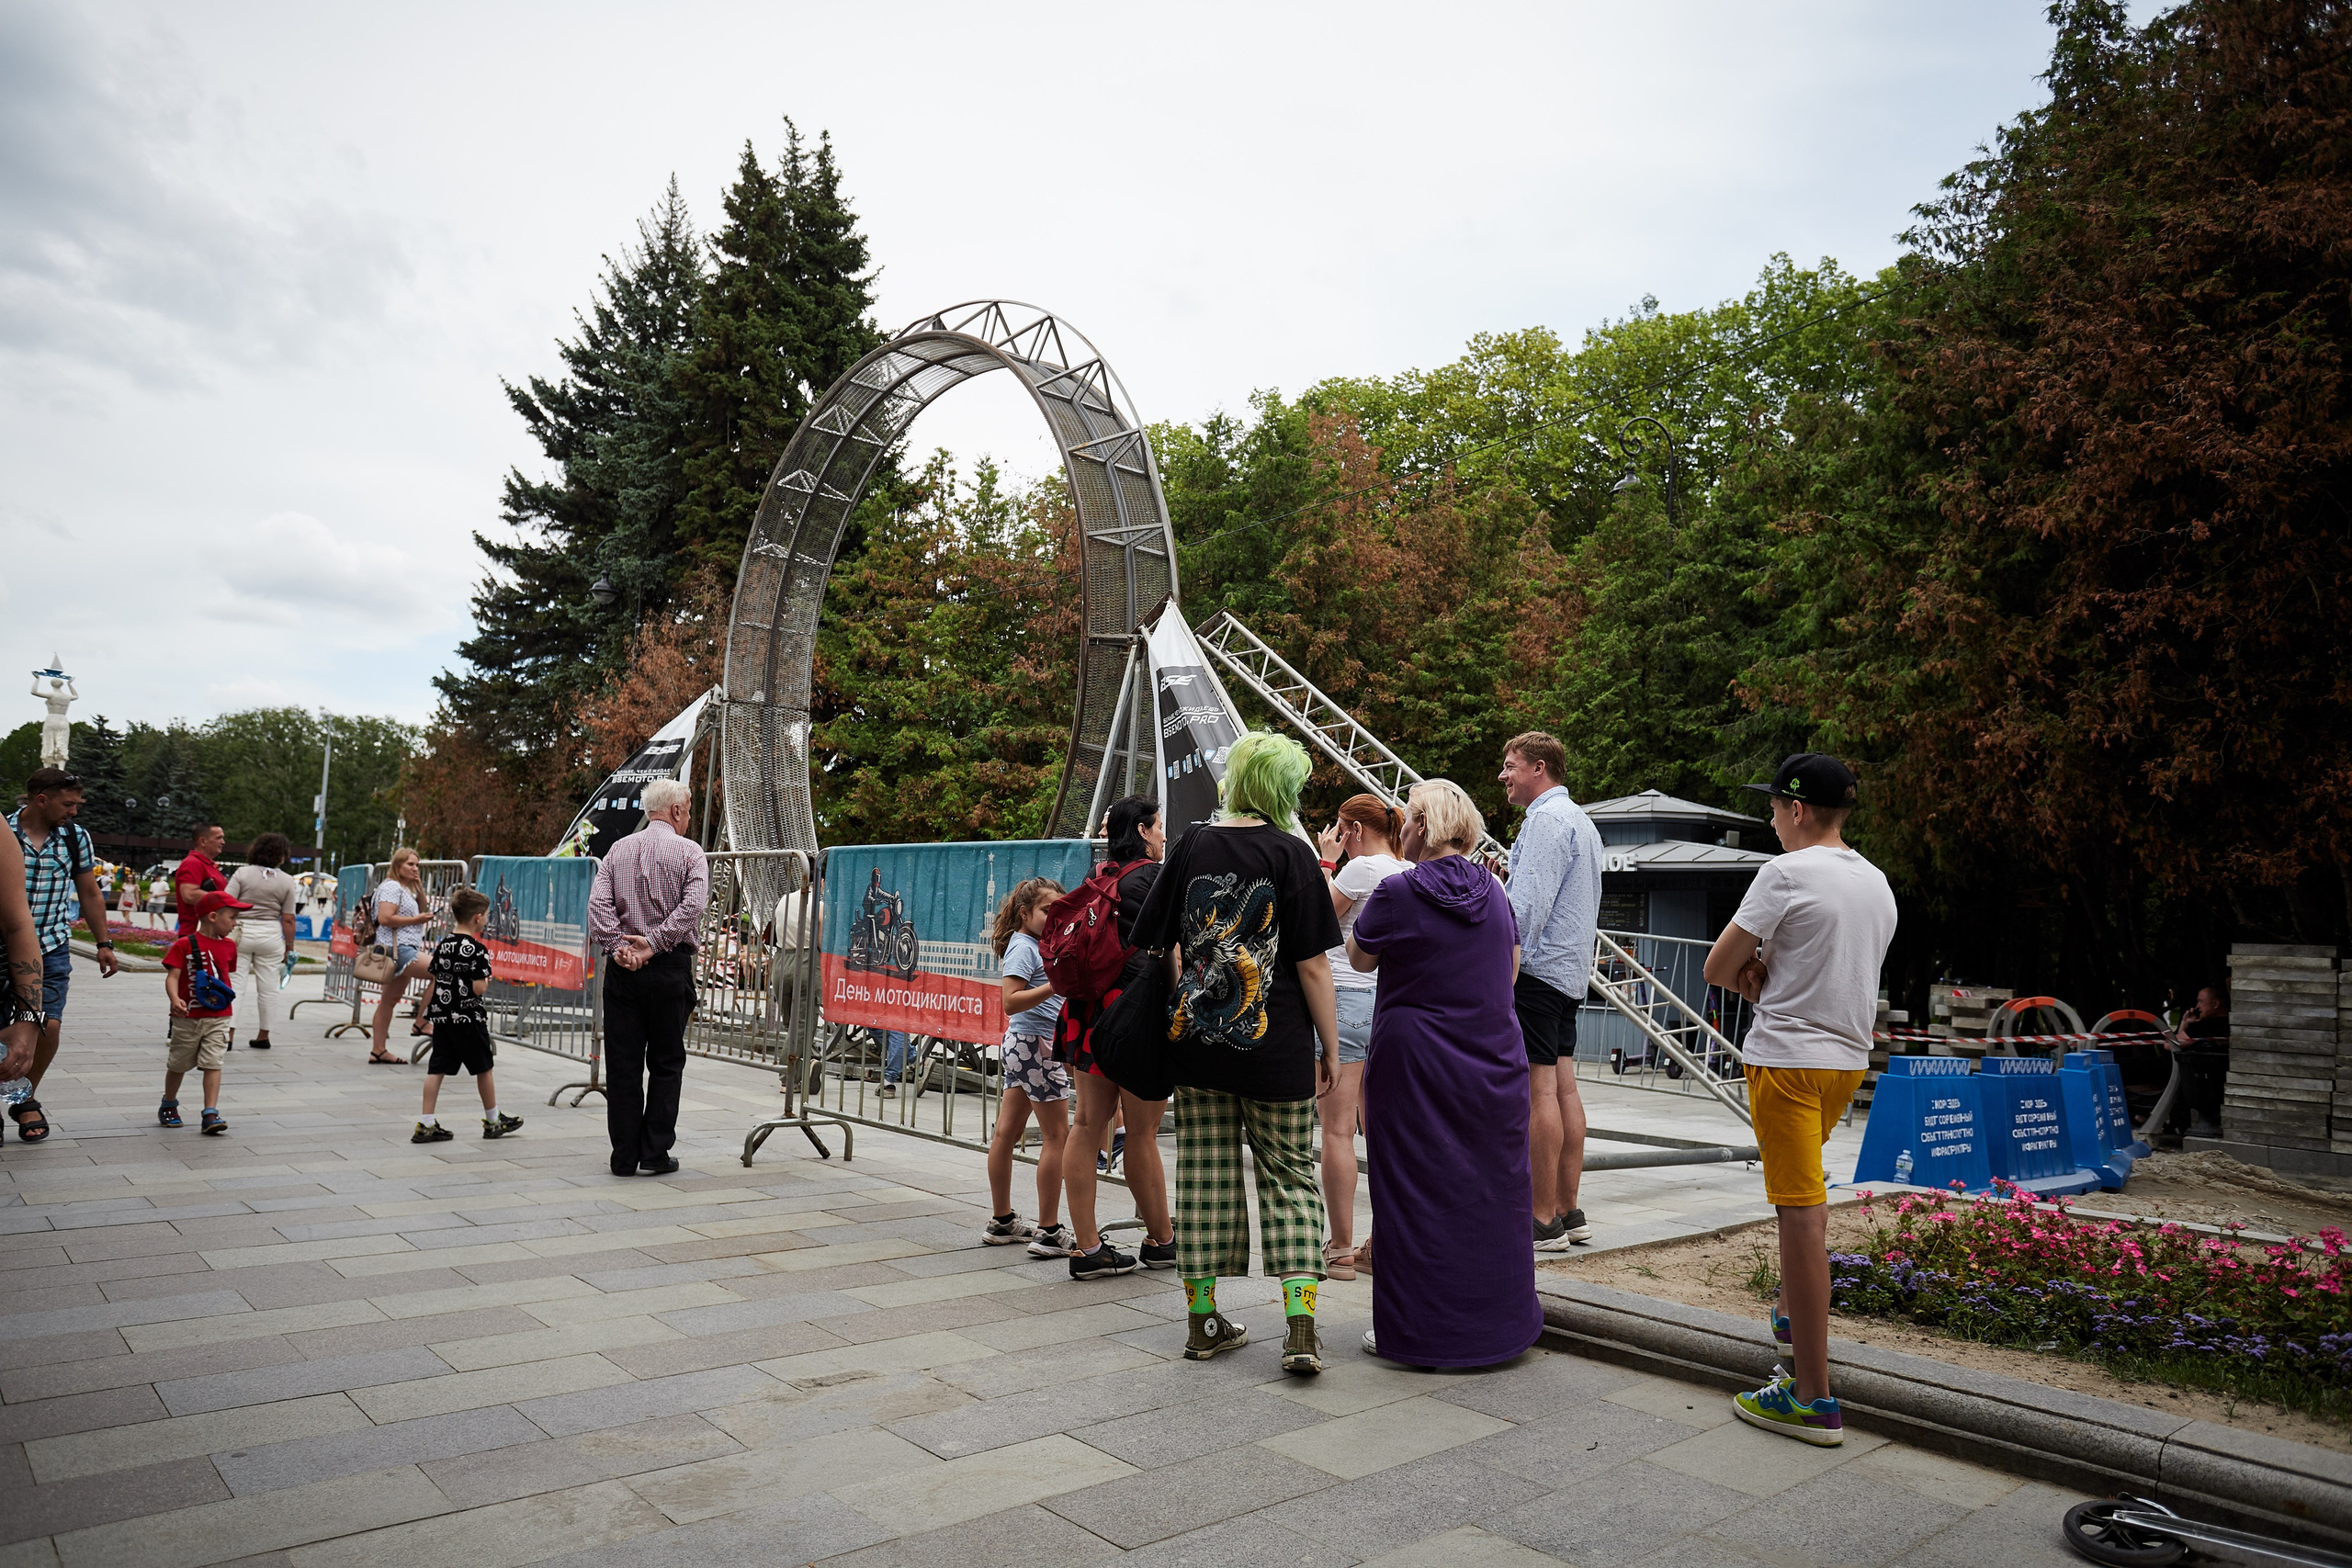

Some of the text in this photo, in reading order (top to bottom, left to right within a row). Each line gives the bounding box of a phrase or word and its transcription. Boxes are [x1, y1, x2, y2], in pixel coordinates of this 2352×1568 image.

[439, 942, 458, 954] ART
[496, 950, 548, 967] мотоциклиста
[834, 977, 870, 1003] День
[874, 987, 983, 1015] мотоциклиста
